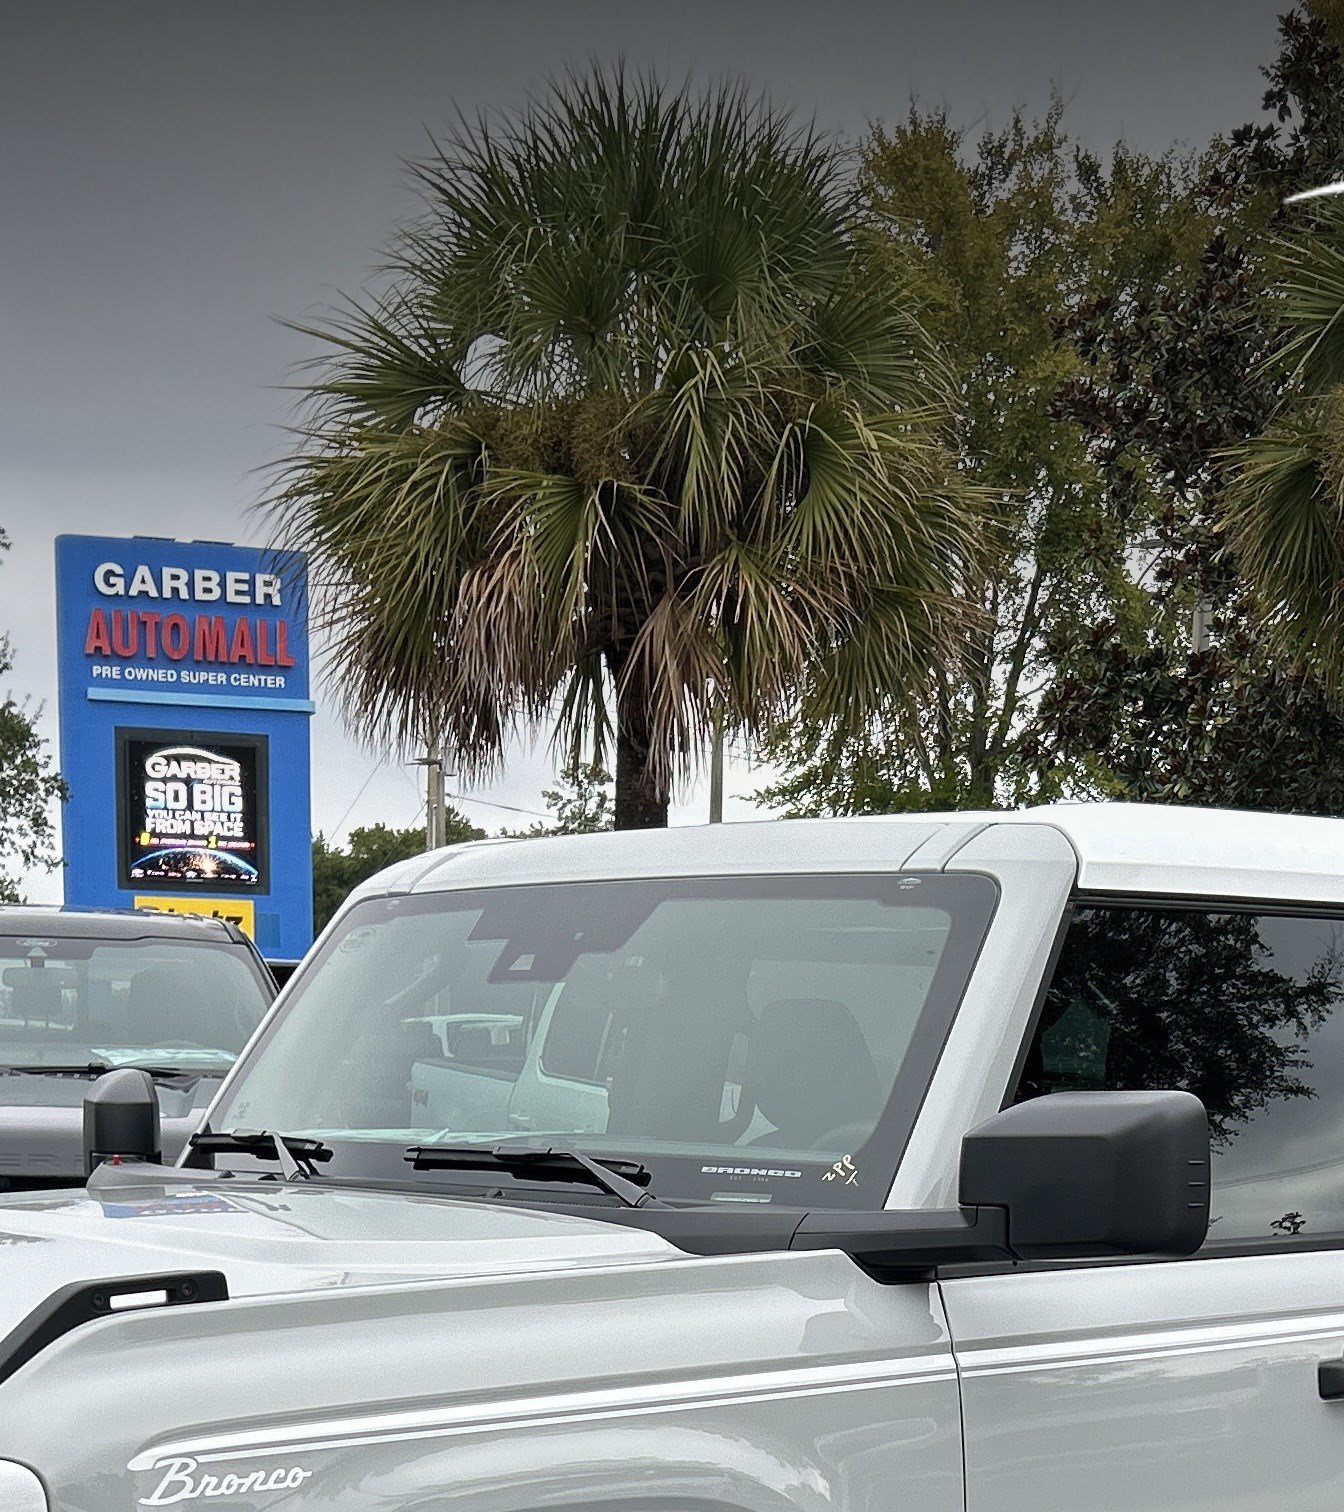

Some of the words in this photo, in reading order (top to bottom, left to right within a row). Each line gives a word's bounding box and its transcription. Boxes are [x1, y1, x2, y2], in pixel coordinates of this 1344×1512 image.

[94, 562, 282, 606] GARBER
[84, 608, 295, 667] AUTOMALL
[92, 665, 121, 680] PRE
[124, 667, 177, 683] OWNED
[180, 670, 227, 685] SUPER
[230, 674, 286, 689] CENTER
[145, 756, 241, 780] GARBER
[145, 781, 188, 809] SO
[193, 784, 243, 812] BIG
[146, 808, 173, 820] YOU
[176, 810, 201, 821] CAN
[145, 817, 192, 835] FROM
[194, 820, 244, 838] SPACE
[701, 1166, 803, 1179] BRONCO
[138, 1456, 313, 1506] Bronco
